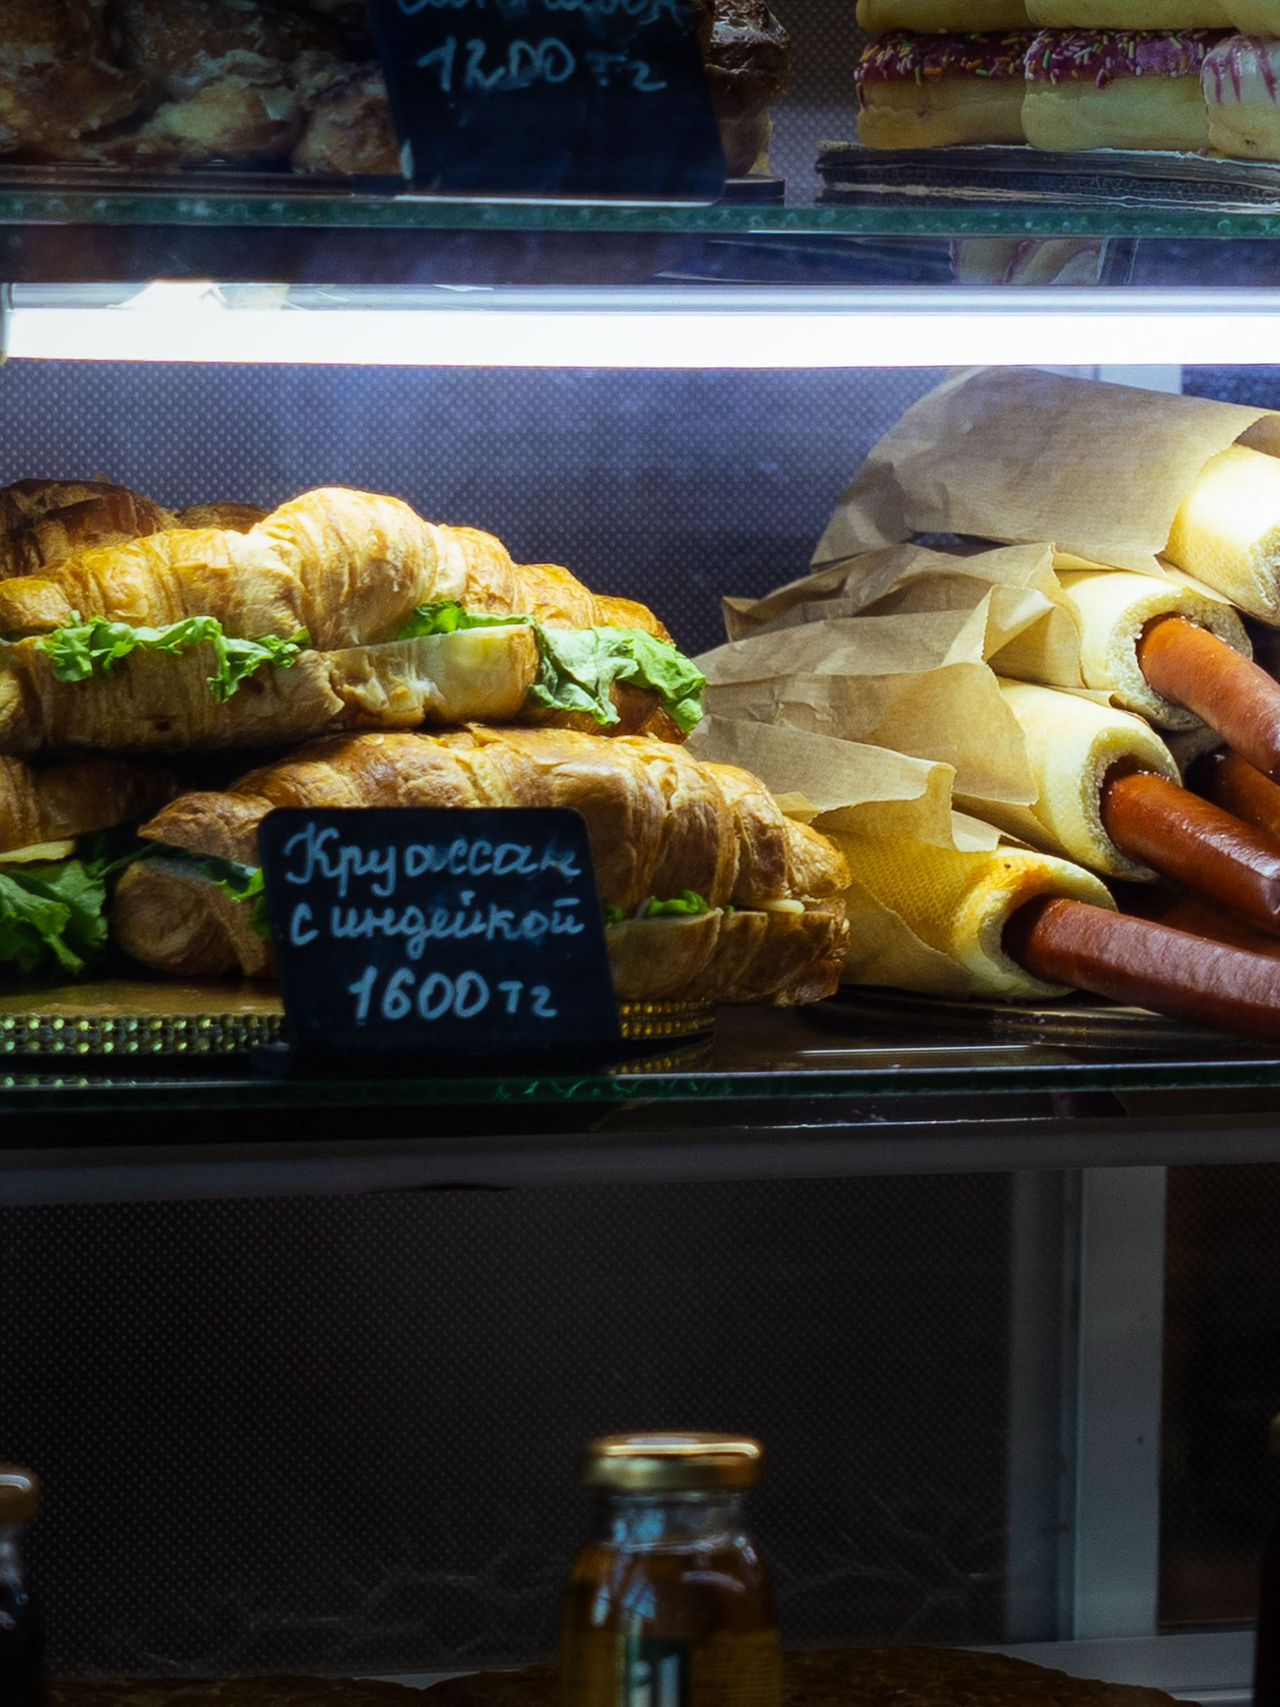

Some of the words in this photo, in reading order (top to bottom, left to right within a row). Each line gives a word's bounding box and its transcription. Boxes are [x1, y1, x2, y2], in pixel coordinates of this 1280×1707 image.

[417, 36, 576, 92] 1200
[330, 889, 586, 960] индейкой
[347, 965, 491, 1024] 1600
